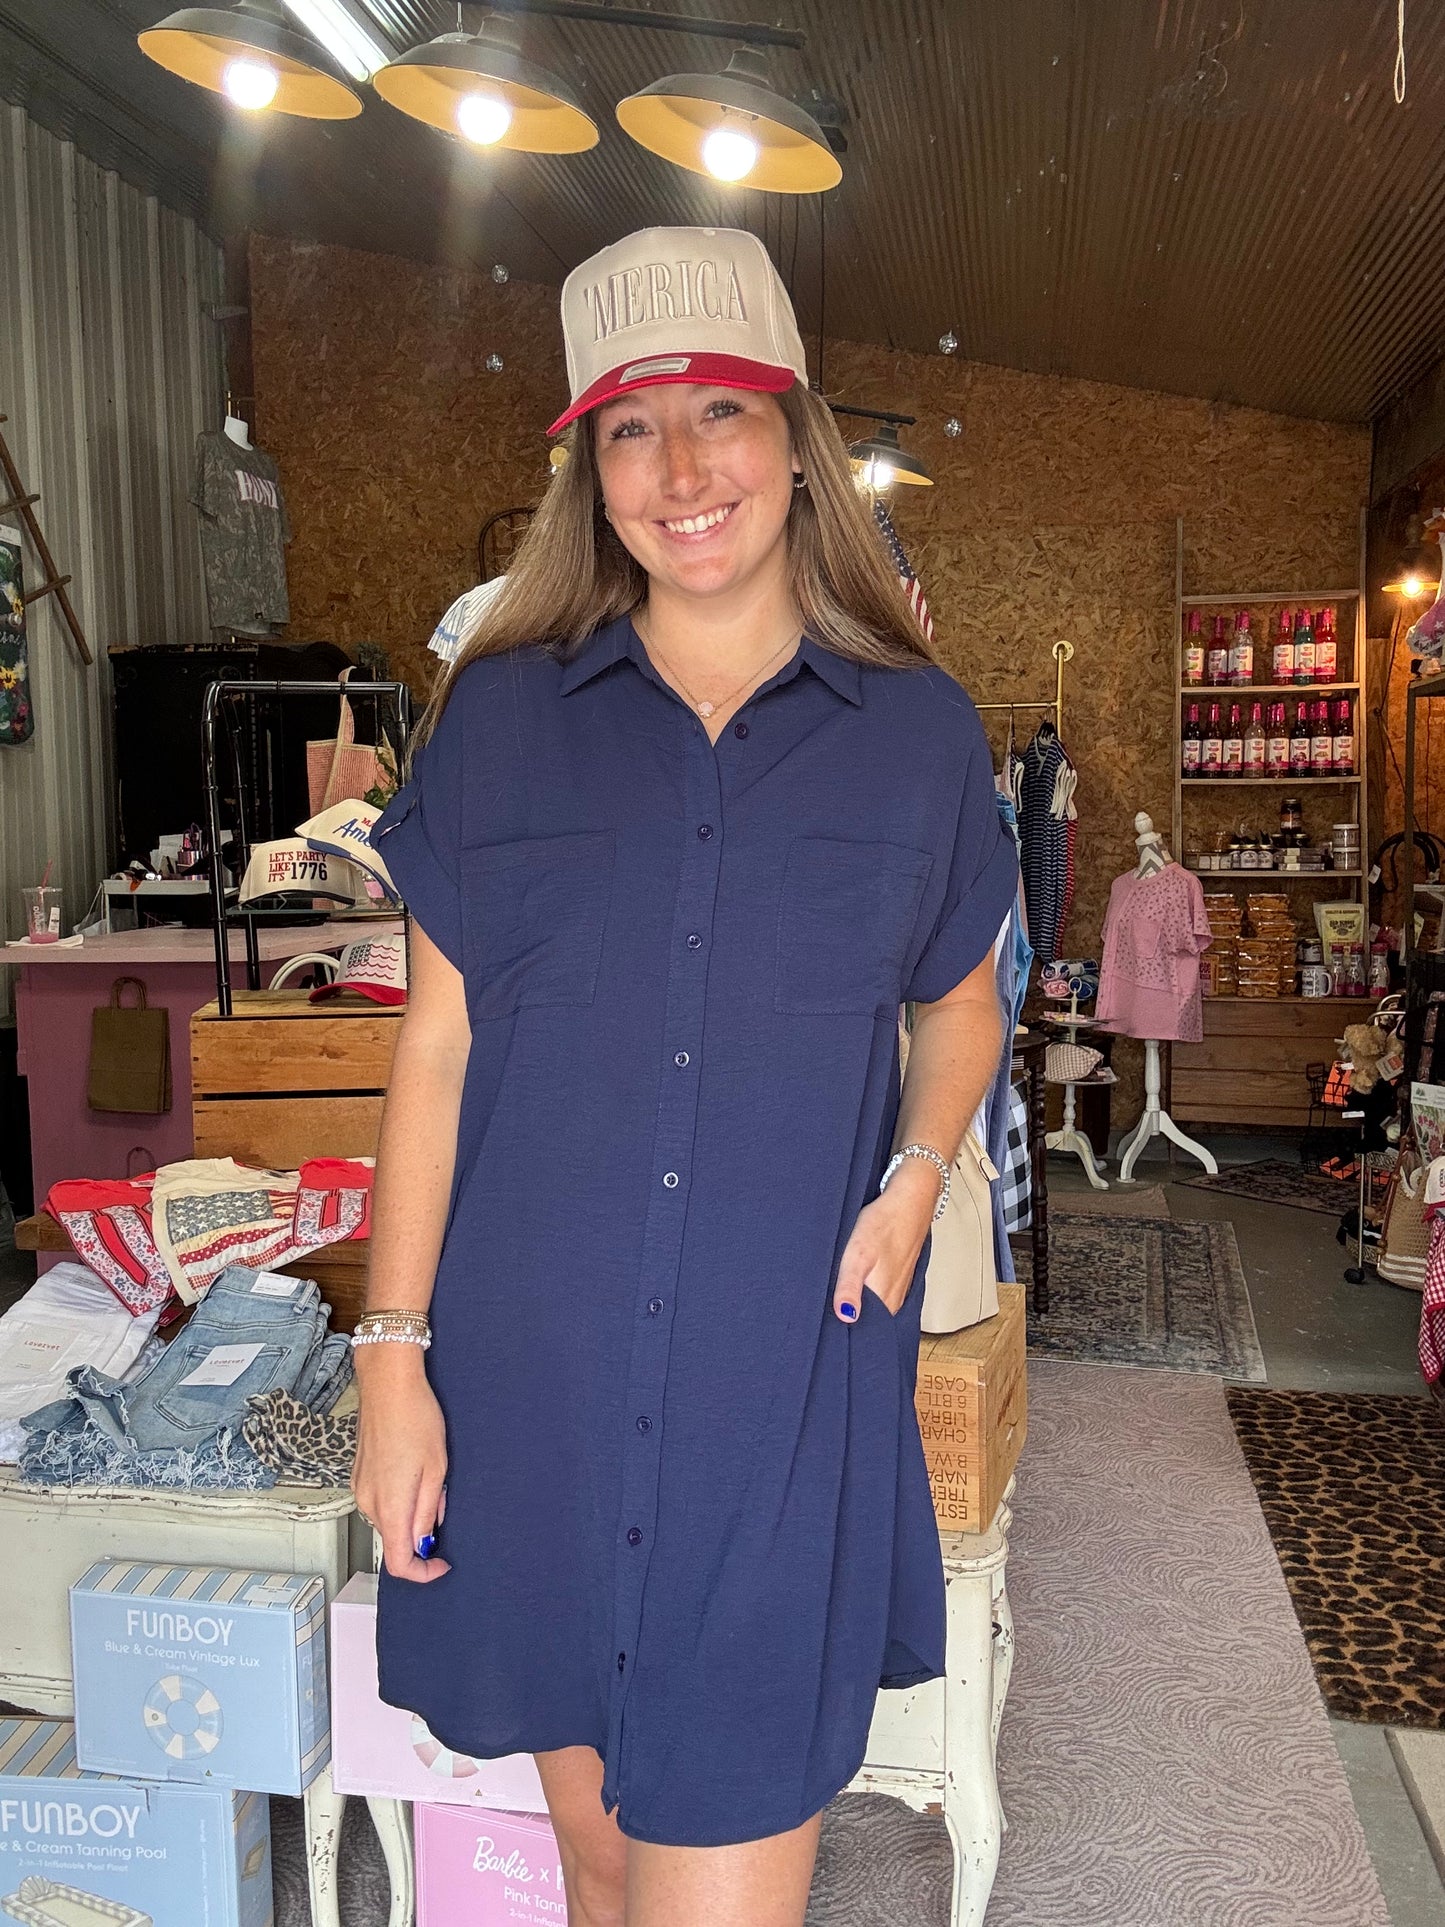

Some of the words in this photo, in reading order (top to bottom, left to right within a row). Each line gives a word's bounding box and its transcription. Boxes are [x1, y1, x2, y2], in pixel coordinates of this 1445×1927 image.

[583, 260, 751, 344] 'MERICA
[269, 850, 294, 863] LET'S
[296, 850, 328, 862] PARTY
[269, 862, 291, 873] LIKE
[291, 862, 328, 881] 1776
[268, 873, 285, 883] IT'S
[924, 1374, 967, 1393] CASE
[919, 1391, 952, 1408] BTL.
[919, 1408, 968, 1428] LIBRA
[921, 1425, 967, 1444] CHAR
[126, 1608, 234, 1647] FUNBOY
[104, 1640, 130, 1655] Blue
[132, 1643, 142, 1655] &
[144, 1645, 187, 1661] Cream
[189, 1649, 237, 1667] Vintage
[239, 1655, 261, 1668] Lux
[0, 1800, 140, 1839] FUNBOY
[12, 1840, 22, 1852] &
[25, 1840, 74, 1856] Cream
[76, 1843, 132, 1861] Tanning
[136, 1846, 168, 1860] Pool
[472, 1836, 534, 1882] Barbie
[539, 1867, 550, 1883] x
[504, 1885, 532, 1906] Pink
